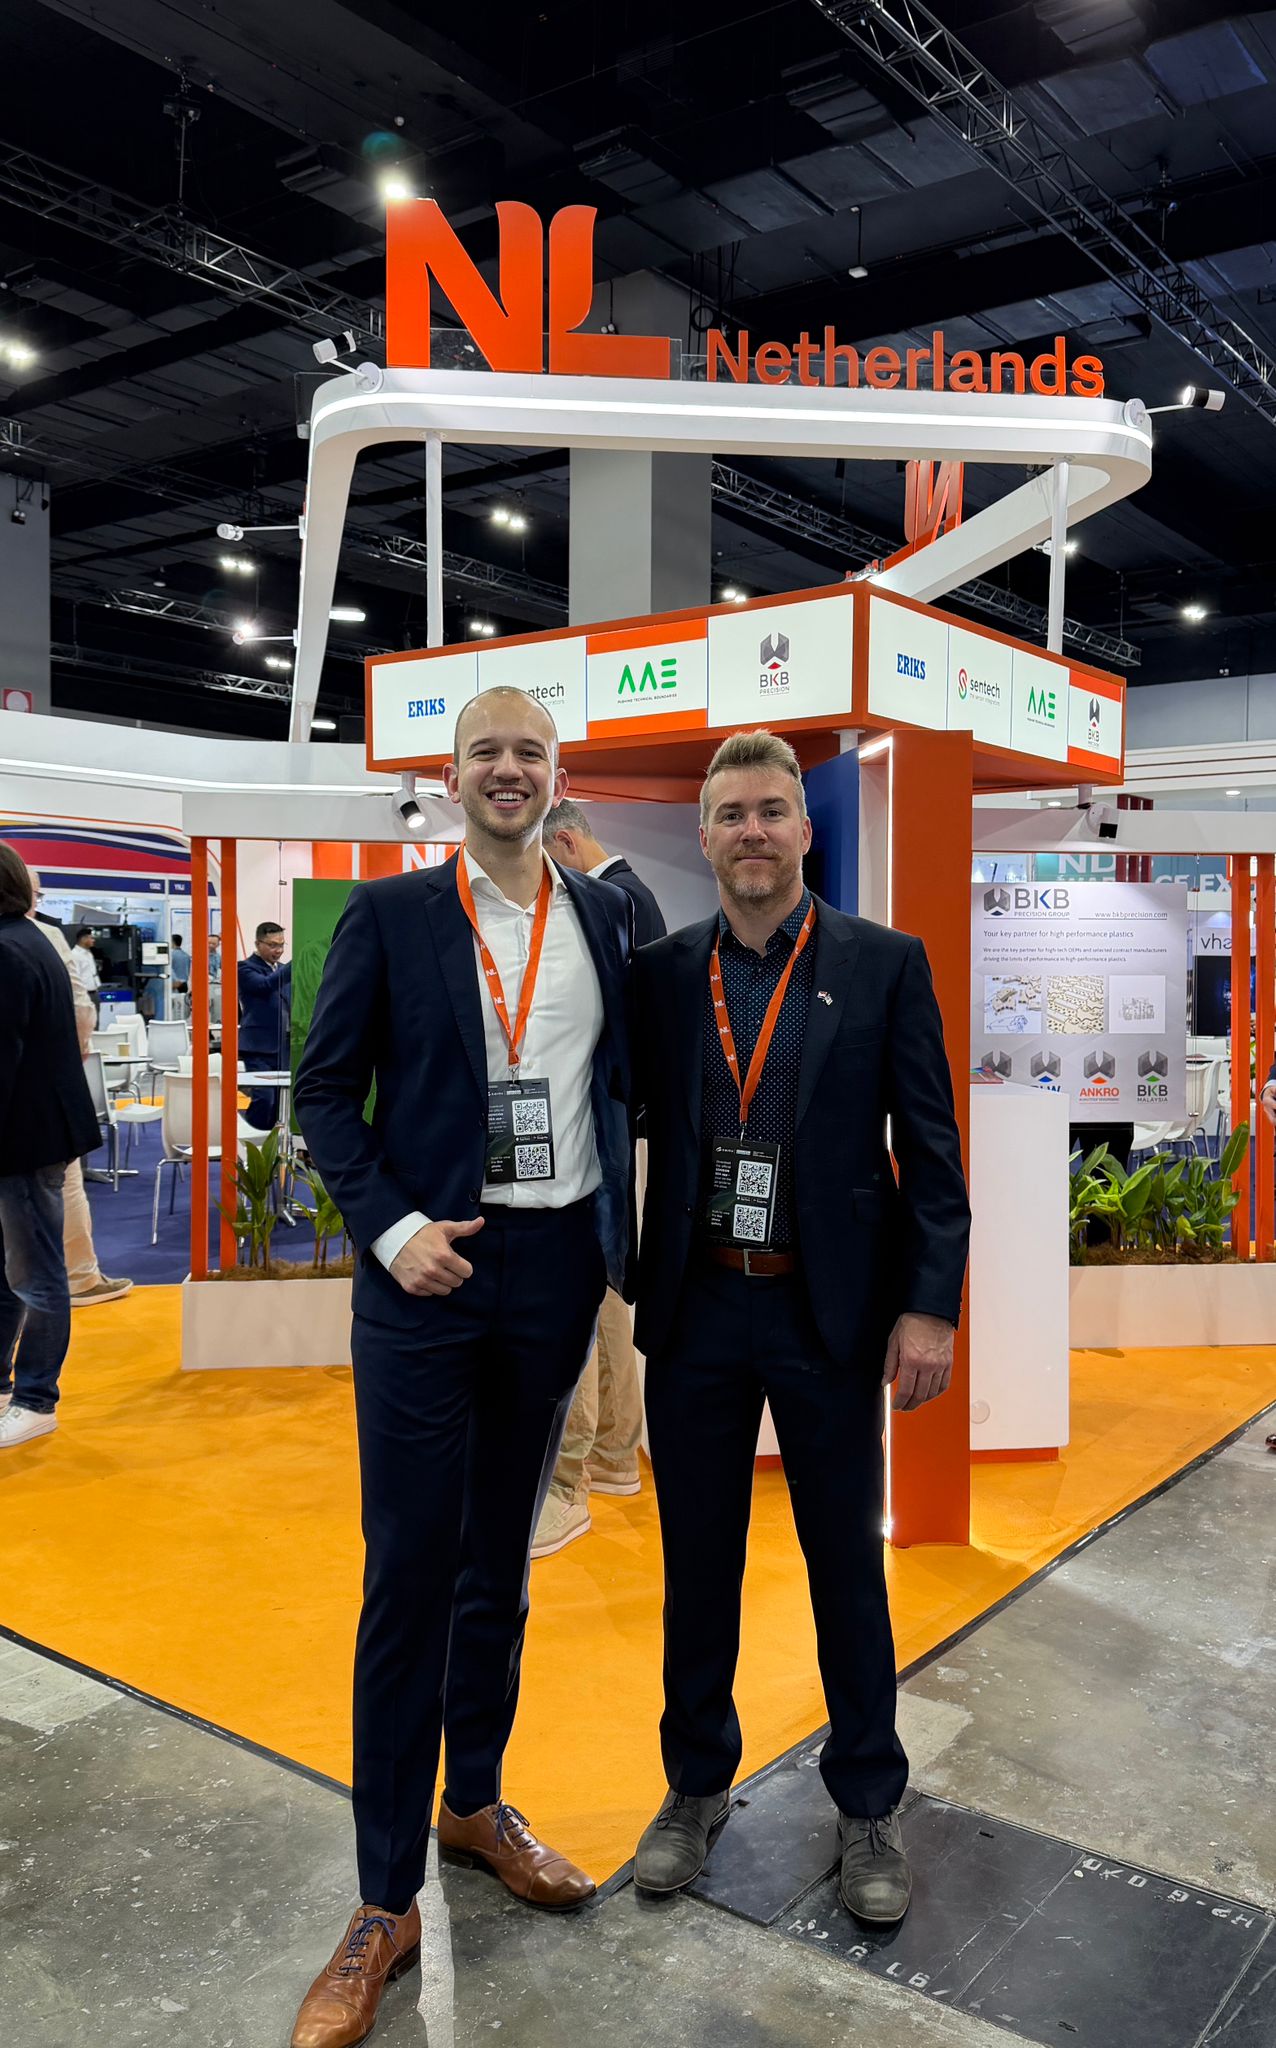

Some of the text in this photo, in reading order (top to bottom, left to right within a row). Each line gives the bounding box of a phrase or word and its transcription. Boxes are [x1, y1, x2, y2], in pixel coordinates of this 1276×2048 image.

[386, 198, 671, 380] NL
[706, 325, 1105, 398] Netherlands
[897, 653, 926, 680] ERIKS
[760, 672, 789, 688] BKB
[528, 682, 565, 699] ntech
[760, 687, 790, 695] PRECISION
[970, 679, 1001, 699] sentech
[408, 698, 446, 718] ERIKS
[1015, 888, 1070, 909] BKB
[1095, 911, 1168, 919] www.bkbprecision.com
[1000, 930, 1012, 939] key
[1014, 931, 1038, 939] partner
[1050, 930, 1064, 938] high
[1066, 930, 1107, 939] performance
[1080, 1088, 1120, 1097] ANKRO
[1137, 1085, 1168, 1097] BKB
